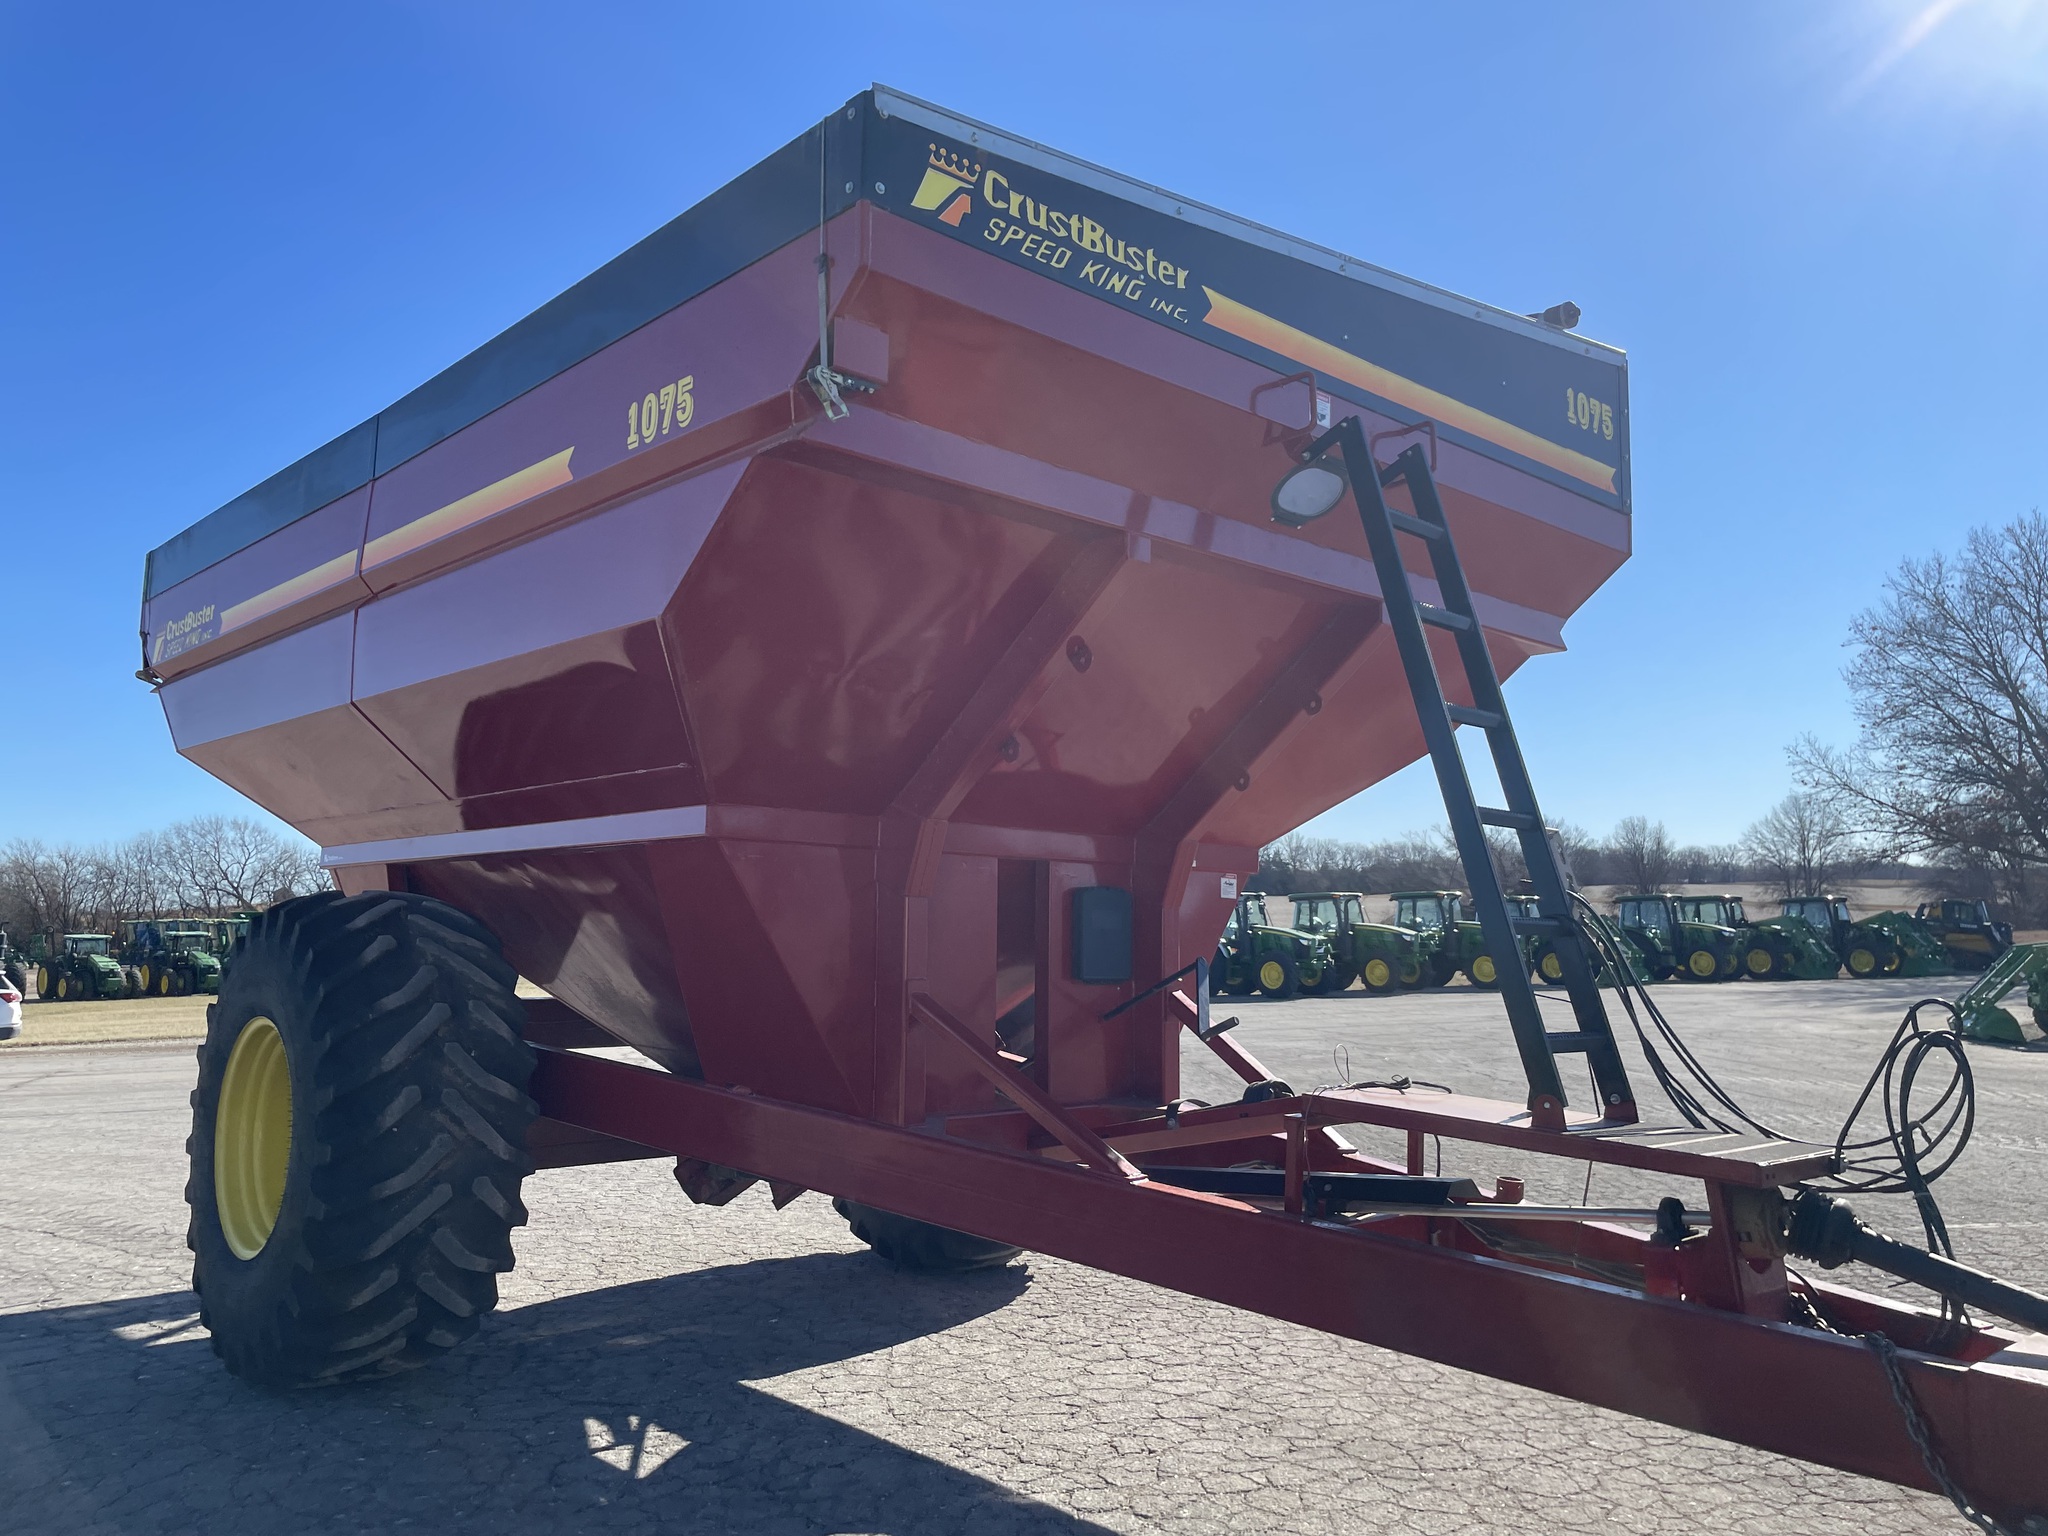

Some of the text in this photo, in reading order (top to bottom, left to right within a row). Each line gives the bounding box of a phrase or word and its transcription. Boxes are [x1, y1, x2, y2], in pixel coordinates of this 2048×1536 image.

[983, 169, 1190, 290] CrustBuster
[983, 217, 1189, 324] SPEED KING INC.
[626, 374, 694, 450] 1075
[1566, 387, 1614, 441] 1075
[166, 604, 216, 641] CrustBuster
